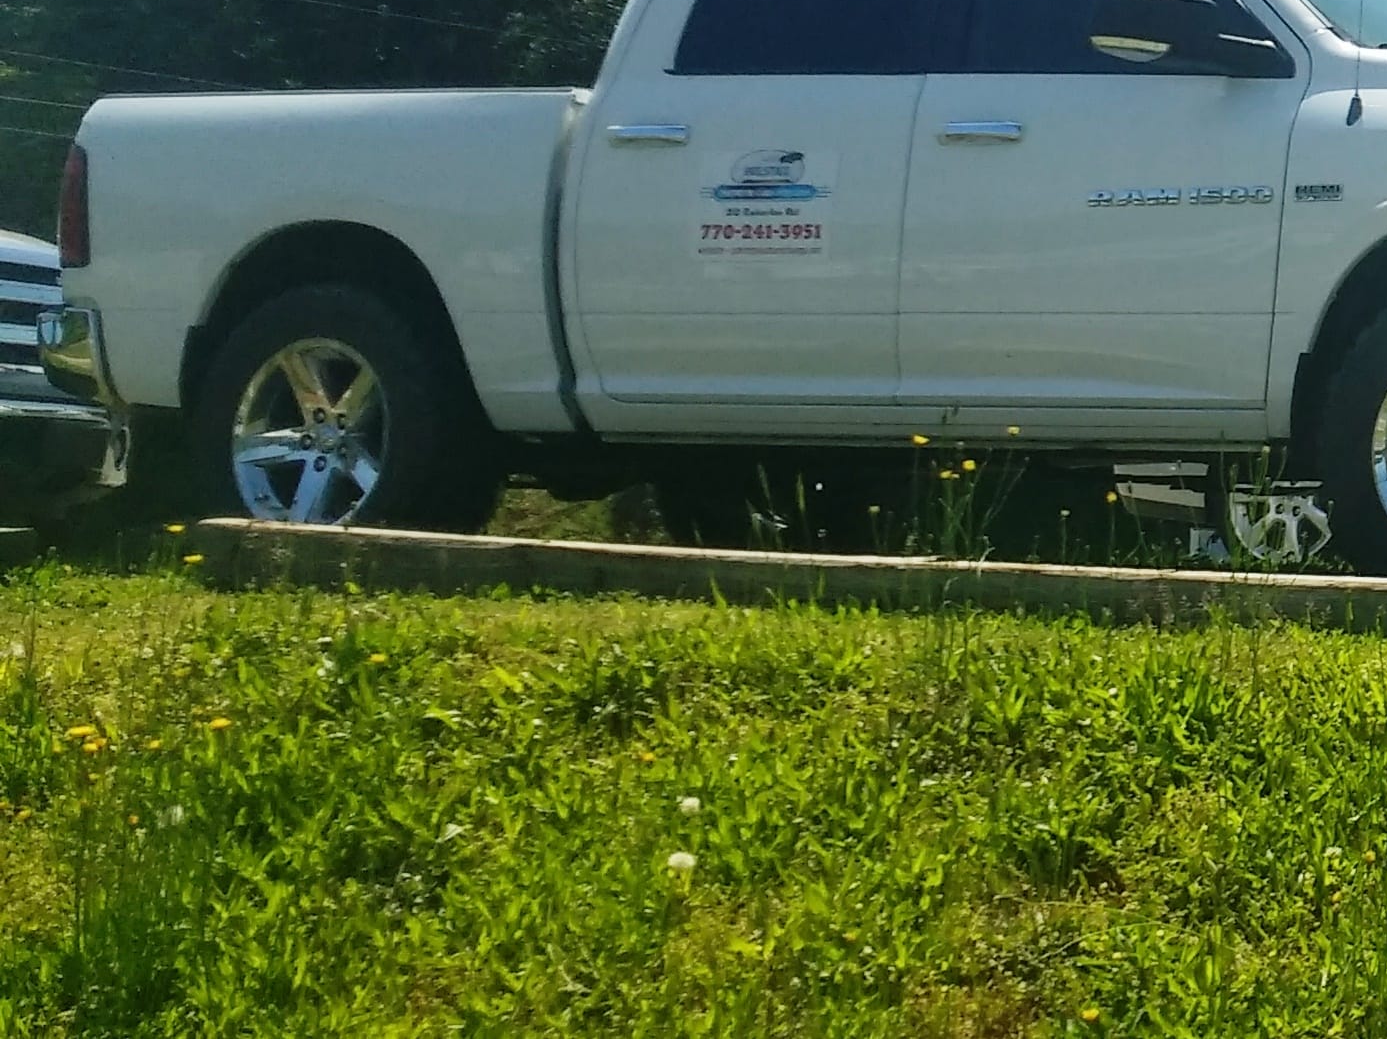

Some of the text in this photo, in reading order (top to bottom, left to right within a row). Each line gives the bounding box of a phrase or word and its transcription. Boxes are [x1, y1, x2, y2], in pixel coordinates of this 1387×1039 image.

[1087, 185, 1273, 207] RAM 1500
[701, 224, 822, 239] 770-241-3951
